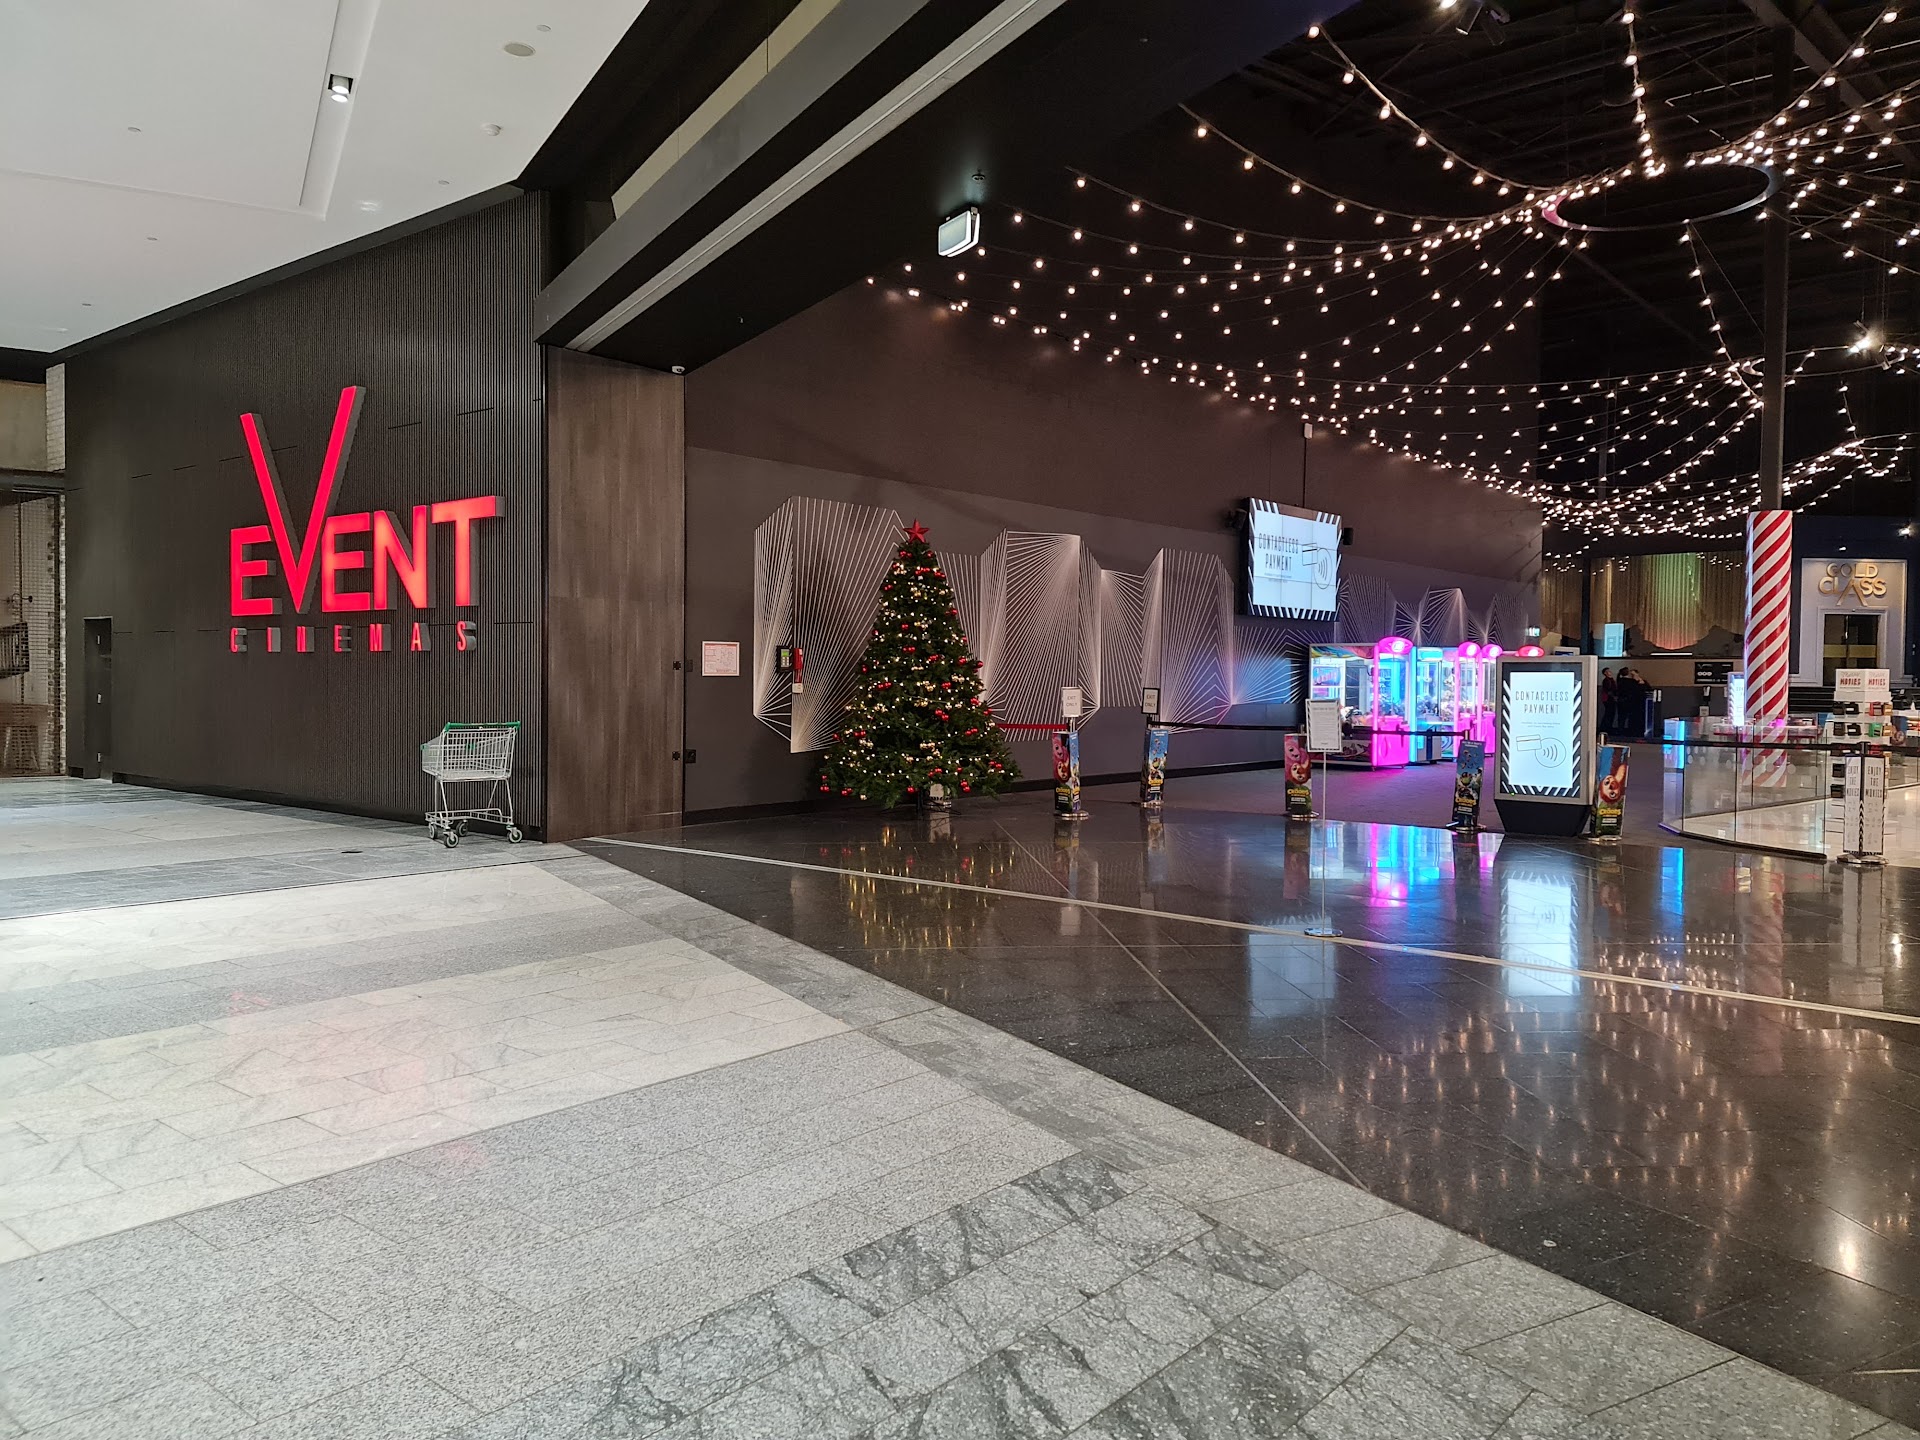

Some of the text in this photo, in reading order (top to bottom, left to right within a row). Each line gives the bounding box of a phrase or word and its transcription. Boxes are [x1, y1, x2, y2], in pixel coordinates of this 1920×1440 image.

[230, 386, 499, 616] EVENT
[1258, 533, 1299, 554] CONTACTLESS
[1265, 553, 1292, 571] PAYMENT
[1826, 562, 1878, 578] GOLD
[1818, 576, 1887, 606] CLASS
[230, 621, 474, 653] CINEMAS
[1840, 678, 1861, 686] MOVIES
[1868, 678, 1886, 686] MOVIES
[1515, 691, 1569, 702] CONTACTLESS
[1523, 704, 1559, 714] PAYMENT
[1867, 766, 1882, 776] ENJOY
[1849, 777, 1857, 786] THE
[1870, 778, 1879, 786] THE
[1865, 788, 1883, 798] MOVIES
